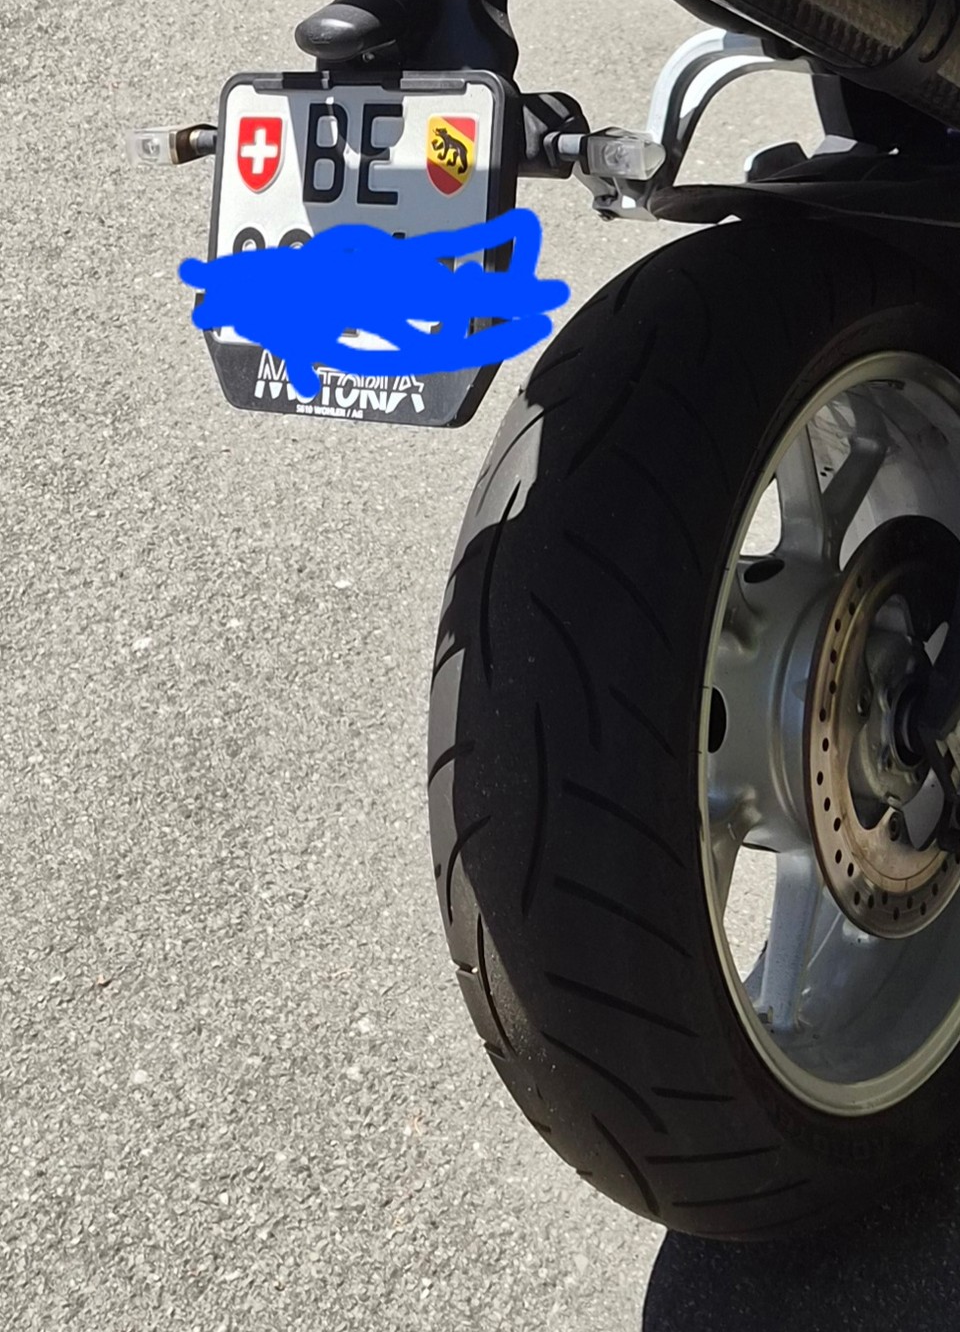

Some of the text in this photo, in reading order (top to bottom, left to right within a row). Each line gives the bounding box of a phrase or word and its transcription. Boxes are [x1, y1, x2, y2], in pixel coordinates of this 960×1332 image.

[303, 103, 405, 206] BE
[314, 406, 346, 417] WOHLEN
[351, 409, 363, 419] AG
